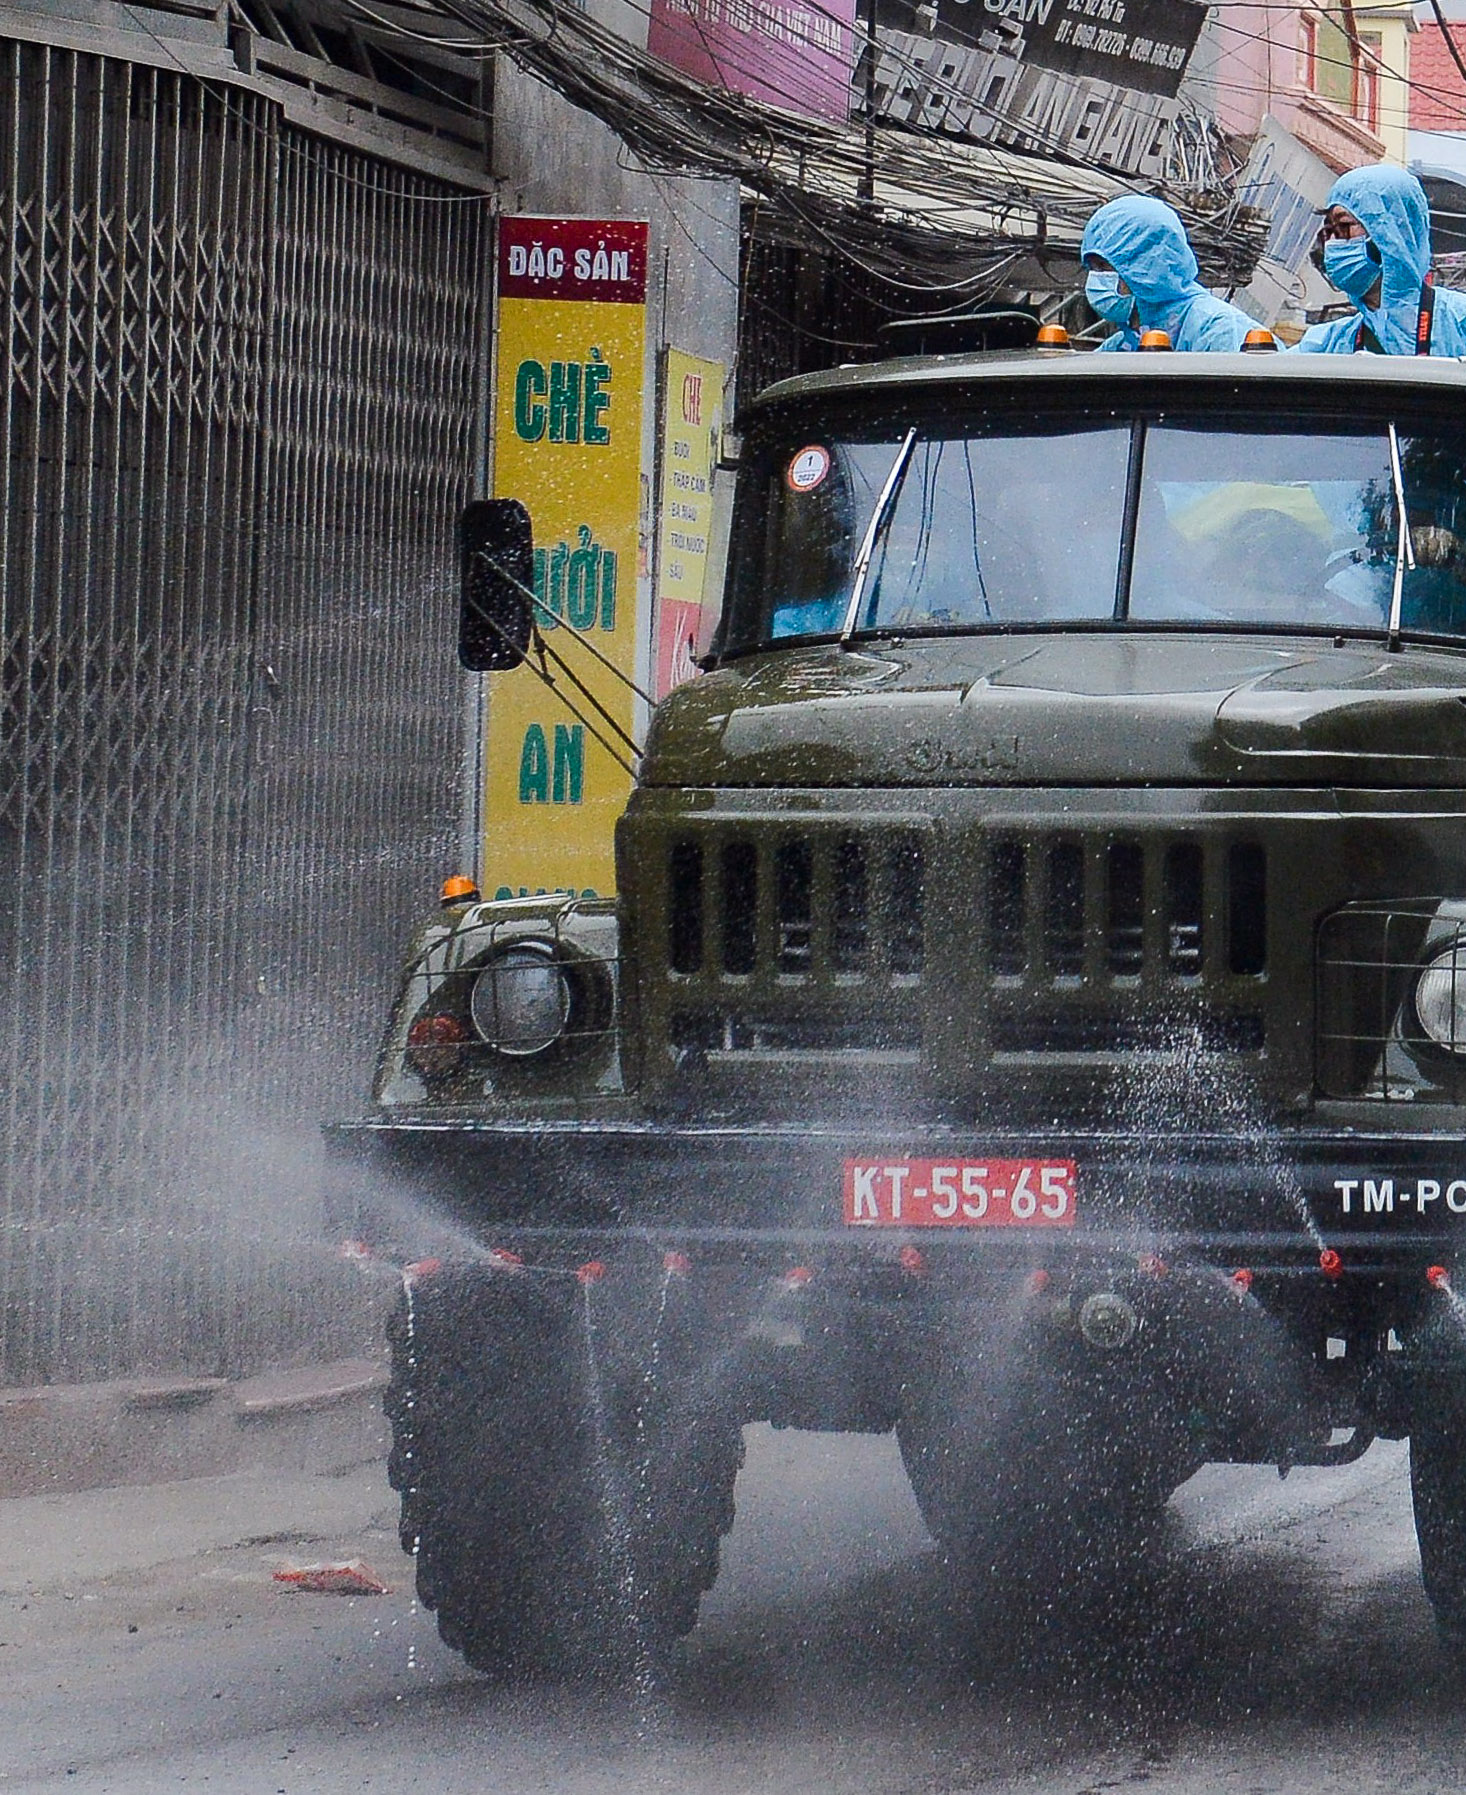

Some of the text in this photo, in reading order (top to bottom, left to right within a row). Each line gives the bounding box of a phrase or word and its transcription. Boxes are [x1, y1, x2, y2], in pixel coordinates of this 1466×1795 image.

[813, 17, 842, 55] NAM
[508, 240, 630, 284] ĐẶC SẢN
[515, 346, 612, 445] CHÈ
[532, 523, 617, 631] ƯỞI
[519, 723, 584, 805] AN
[853, 1167, 1068, 1218] KT-55-65
